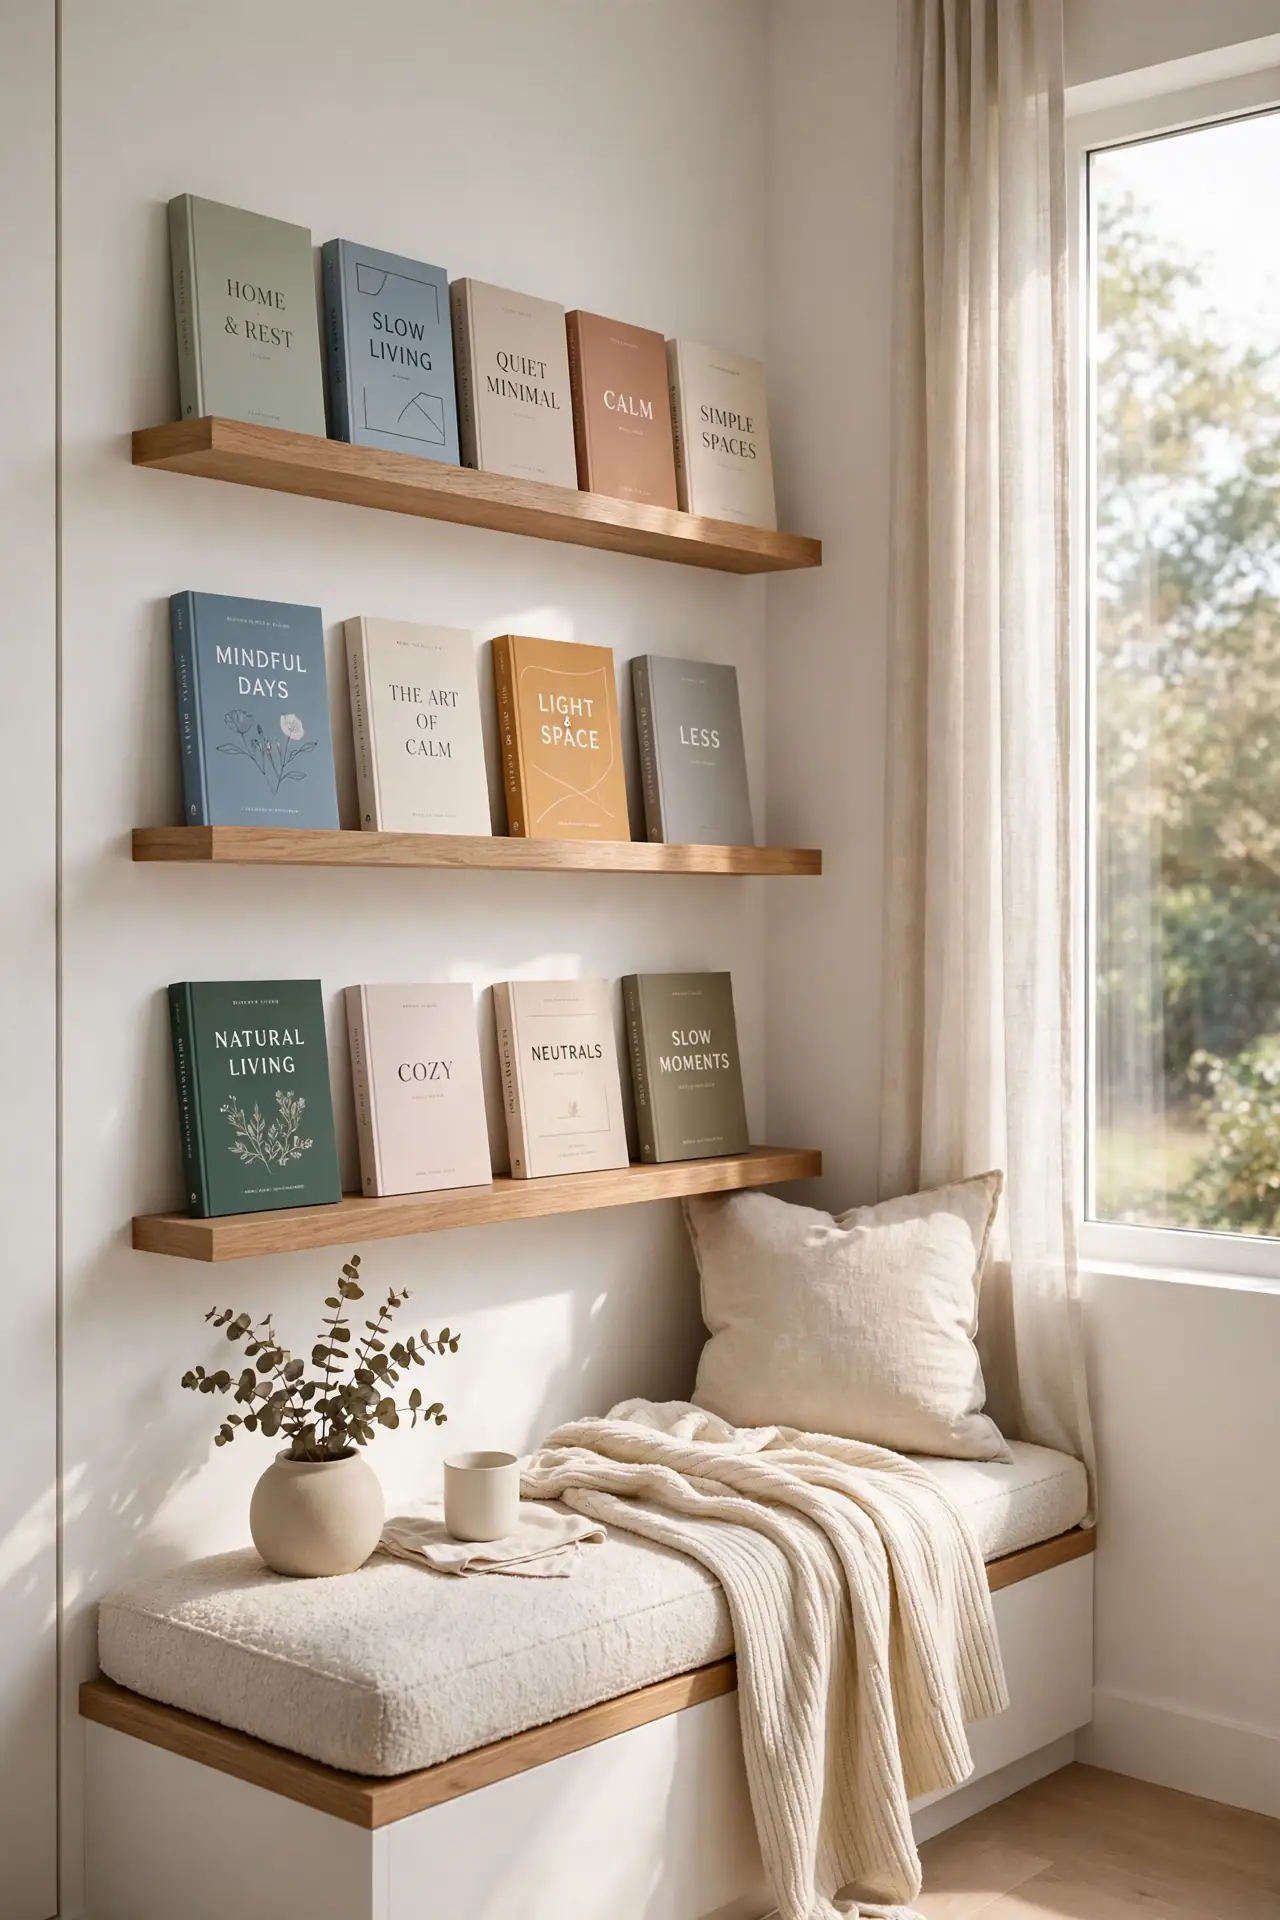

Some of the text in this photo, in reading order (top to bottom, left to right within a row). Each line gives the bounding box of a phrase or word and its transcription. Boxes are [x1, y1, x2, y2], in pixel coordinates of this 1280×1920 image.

[227, 278, 286, 311] HOME
[224, 316, 293, 350] & REST
[372, 311, 425, 341] SLOW
[369, 338, 432, 371] LIVING
[496, 351, 547, 380] QUIET
[486, 375, 561, 411] MINIMAL
[603, 389, 653, 420] CALM
[700, 405, 755, 434] SIMPLE
[702, 432, 757, 460] SPACES
[215, 645, 307, 674] MINDFUL
[238, 676, 289, 699] DAYS
[388, 684, 459, 708] THE ART
[538, 693, 594, 718] LIGHT
[416, 713, 438, 731] OF
[563, 716, 571, 728] &
[405, 738, 452, 758] CALM
[541, 725, 600, 750] SPACE
[679, 725, 720, 749] LESS
[215, 1028, 305, 1049] NATURAL
[671, 1029, 712, 1047] SLOW
[531, 1043, 602, 1061] NEUTRALS
[659, 1052, 730, 1074] MOMENTS
[228, 1055, 296, 1076] LIVING
[397, 1060, 453, 1083] COZY
